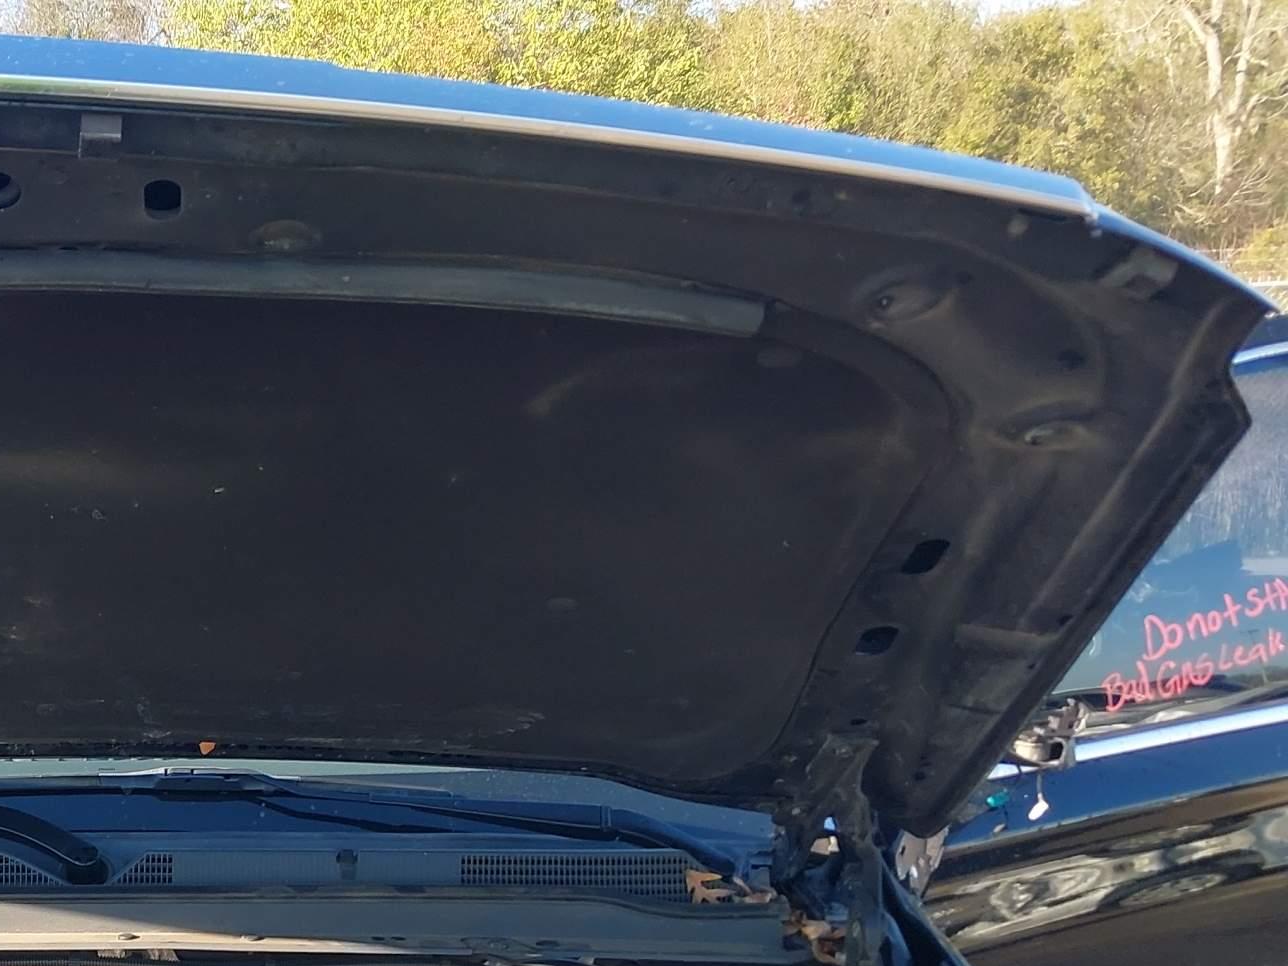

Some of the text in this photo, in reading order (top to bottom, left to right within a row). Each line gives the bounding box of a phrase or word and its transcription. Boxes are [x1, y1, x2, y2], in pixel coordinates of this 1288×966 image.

[1143, 614, 1183, 661] Do
[1187, 593, 1241, 641] not
[1102, 660, 1153, 712] Bad
